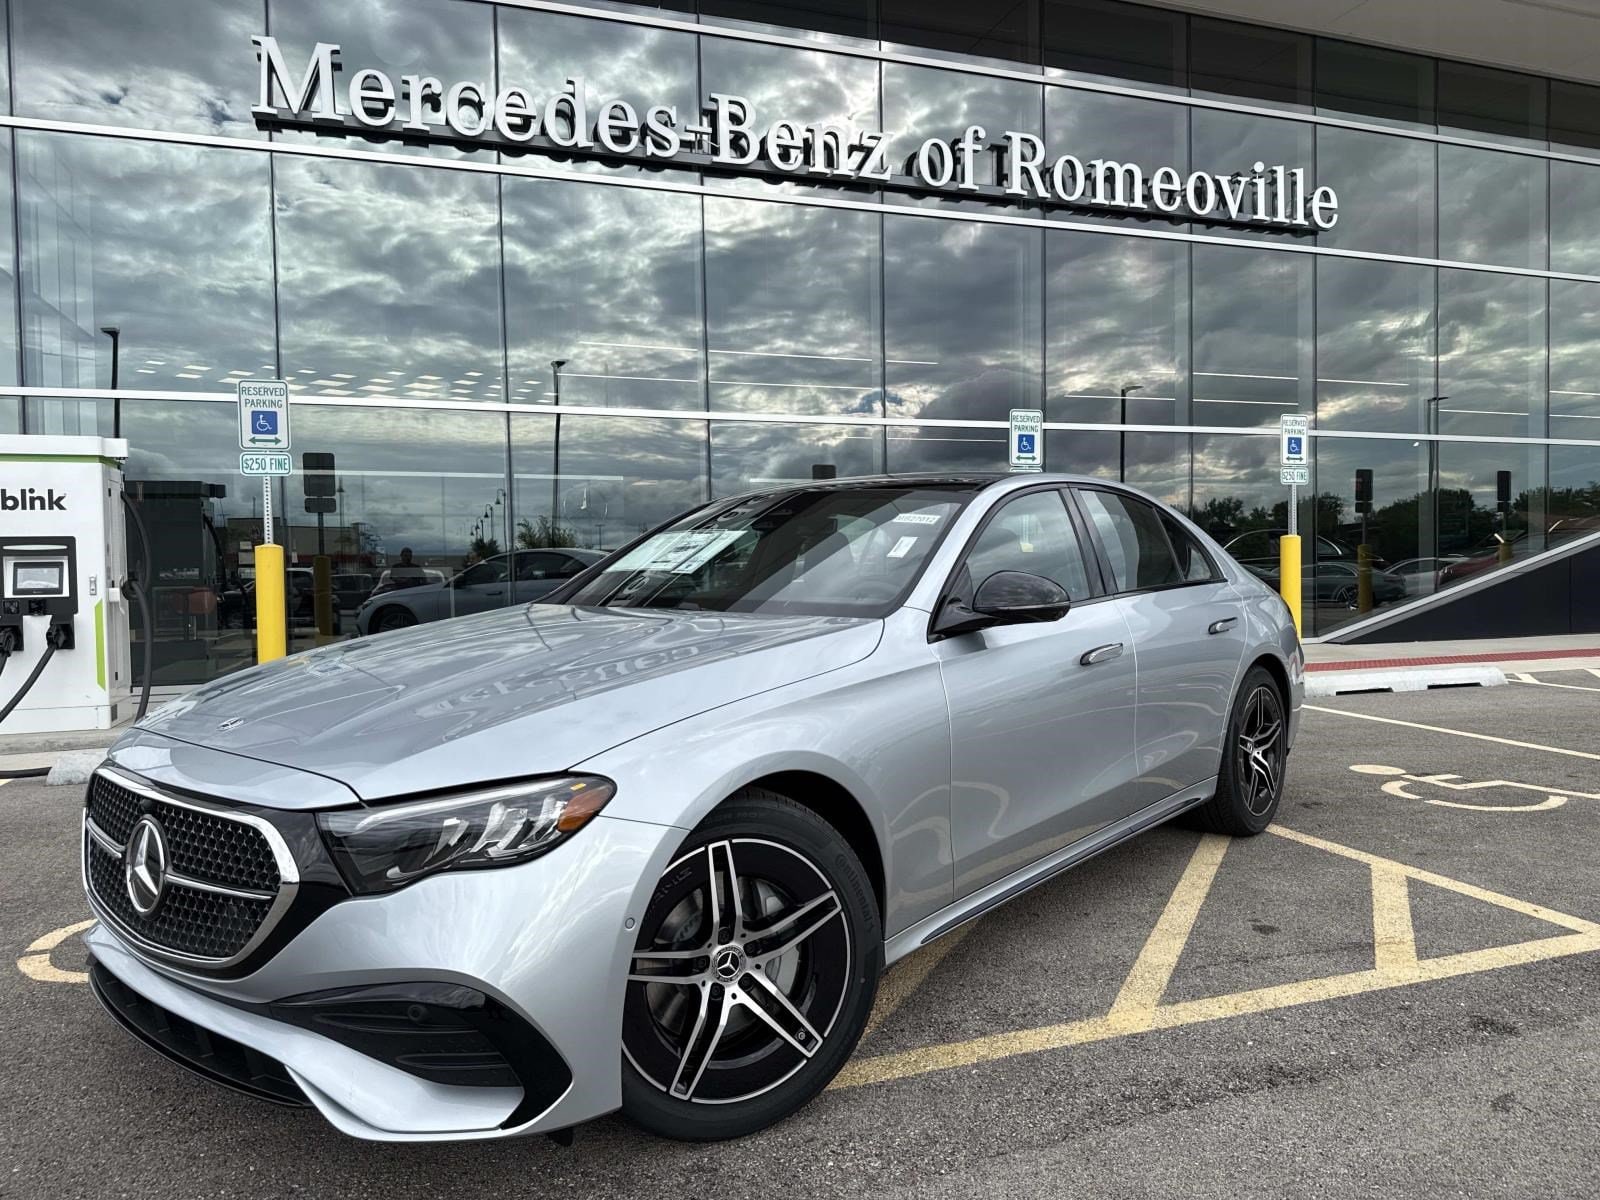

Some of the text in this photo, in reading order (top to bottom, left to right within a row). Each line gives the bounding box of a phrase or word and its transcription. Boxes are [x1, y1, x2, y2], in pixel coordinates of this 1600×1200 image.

[250, 35, 1339, 229] Mercedes-Benz of Romeoville
[241, 386, 285, 397] RESERVED
[244, 398, 283, 409] PARKING
[1012, 415, 1040, 423] RESERVED
[1014, 424, 1039, 433] PARKING
[243, 457, 288, 471] $250 FINE
[0, 487, 67, 511] blink
